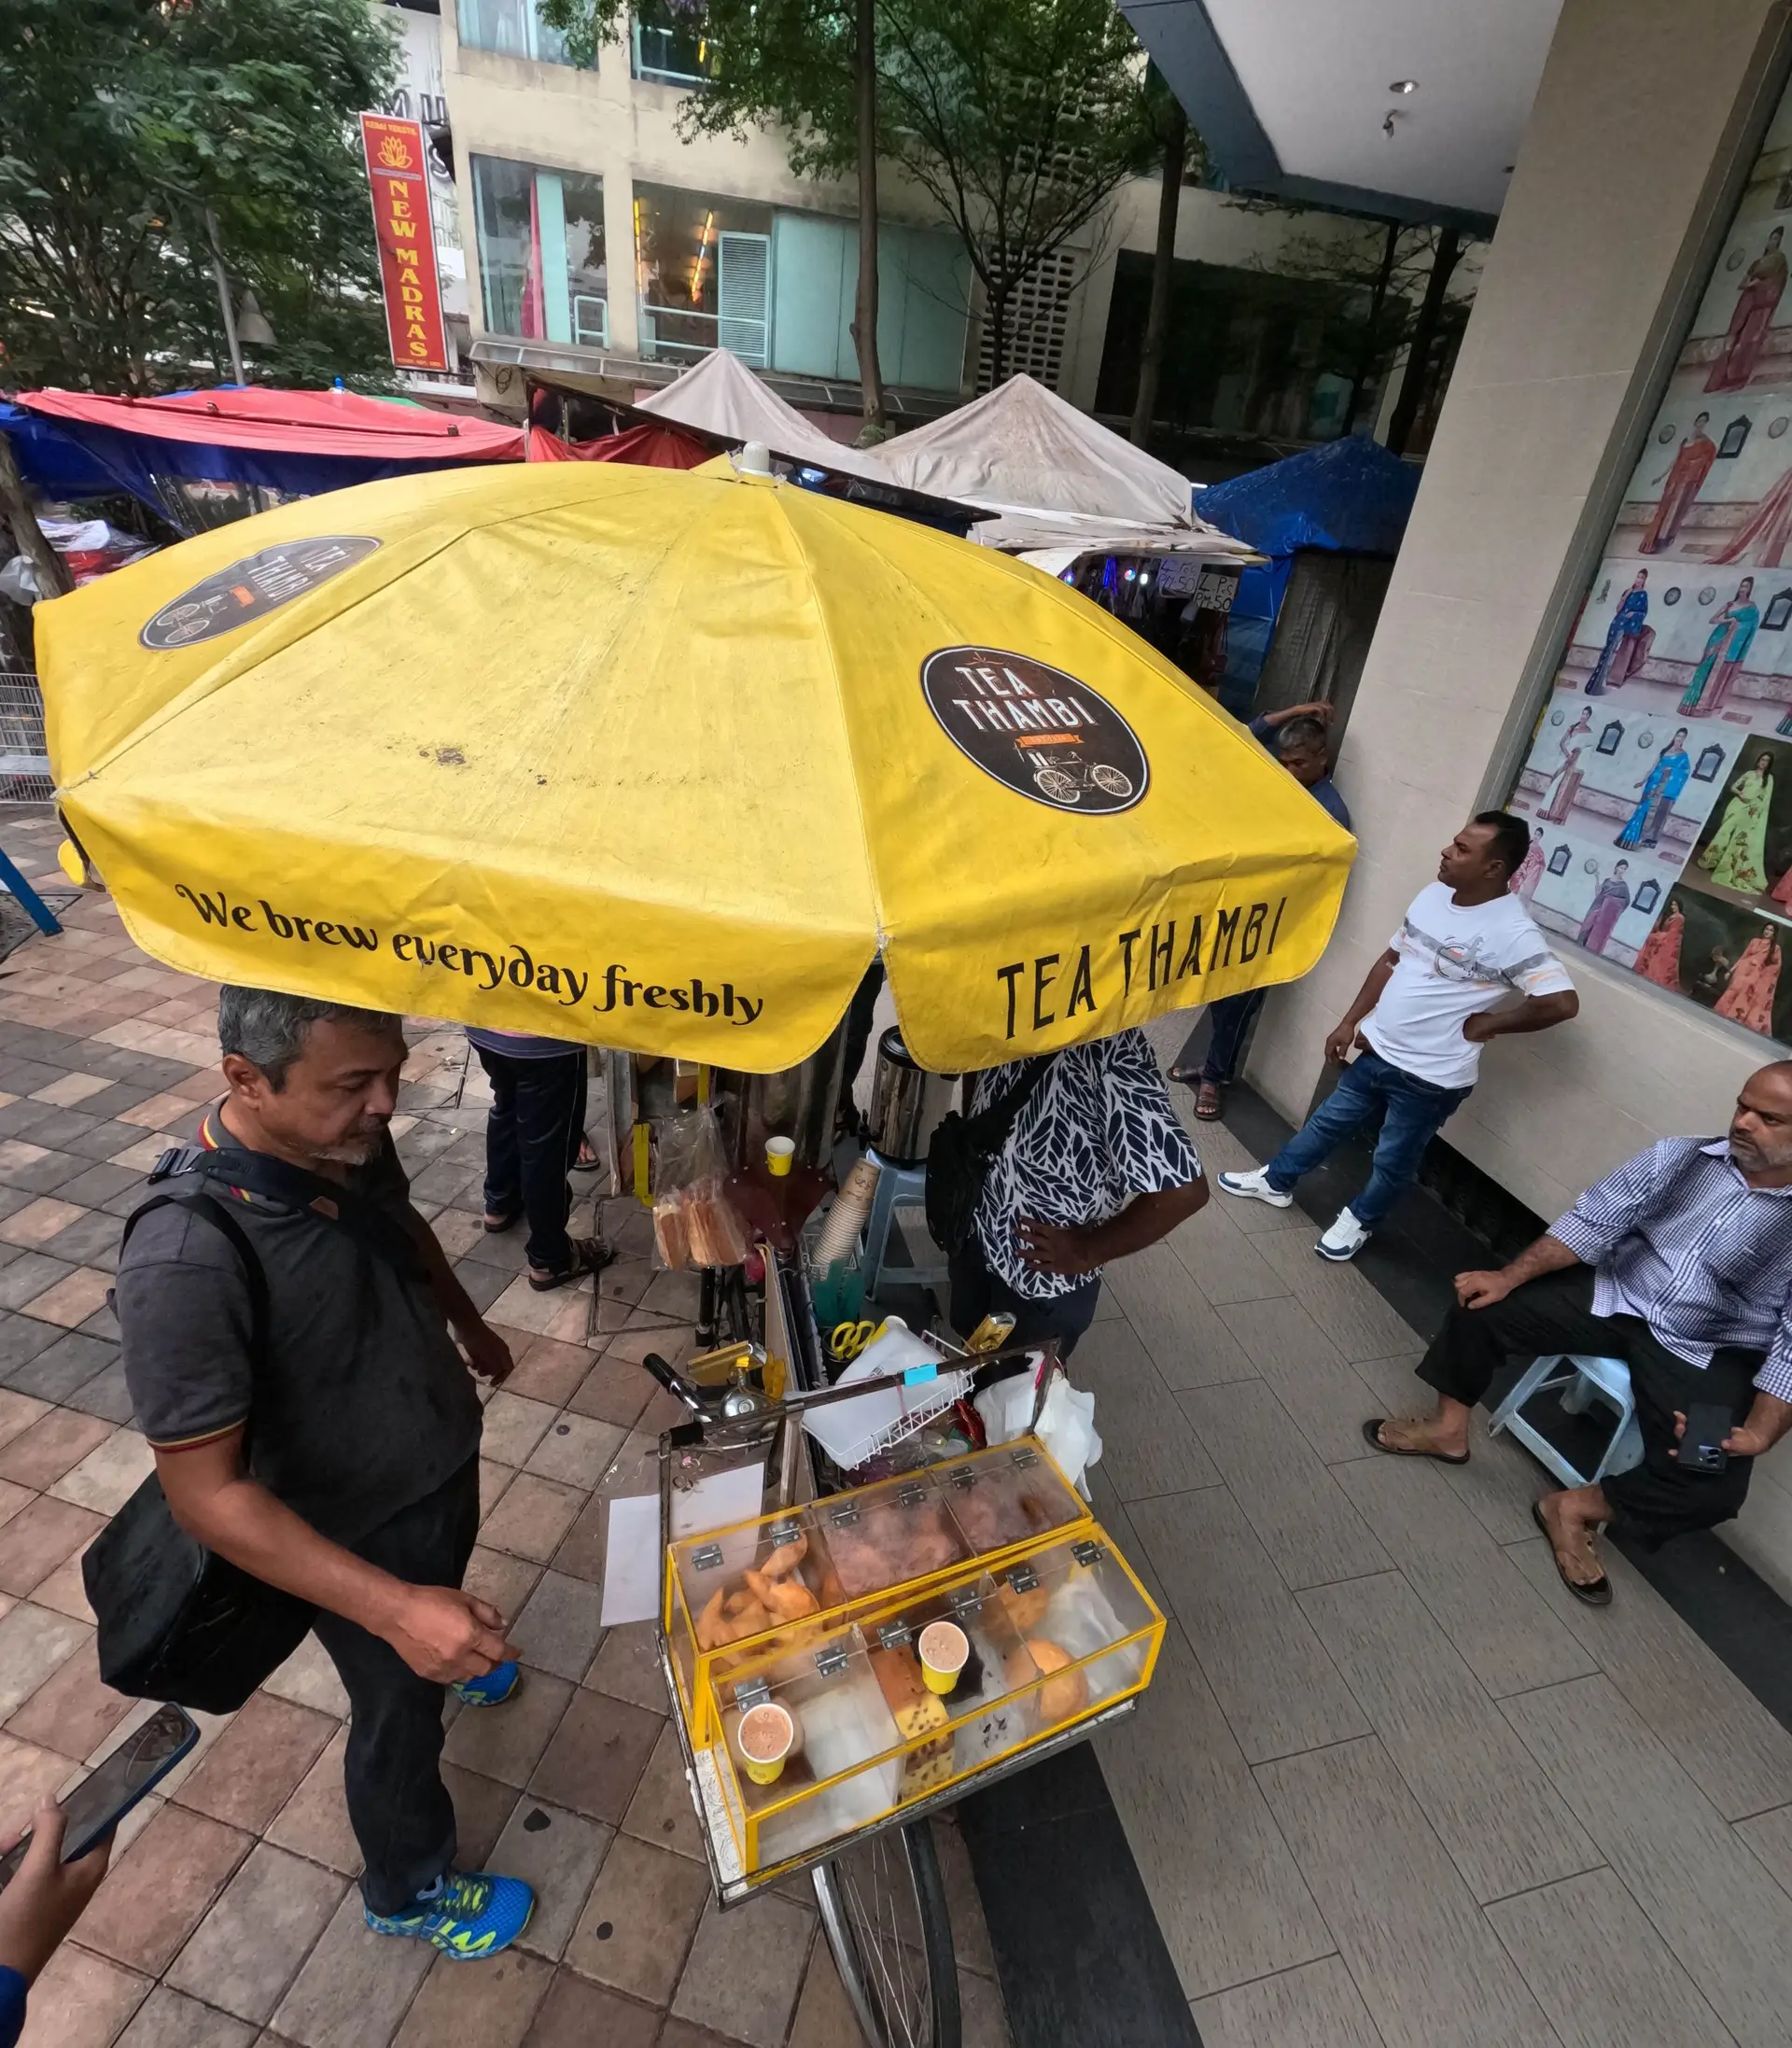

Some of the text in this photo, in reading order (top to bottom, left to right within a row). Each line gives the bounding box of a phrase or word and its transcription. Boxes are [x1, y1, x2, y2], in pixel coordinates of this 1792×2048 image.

[389, 179, 417, 239] NEW
[396, 247, 427, 357] MADRAS
[247, 555, 314, 601] THAMBI
[301, 545, 350, 573] TEA
[954, 666, 1035, 696] TEA
[951, 696, 1098, 731] THAMBI
[175, 883, 763, 1026] We brew everyday freshly
[997, 896, 1288, 1041] TEA THAMBI
